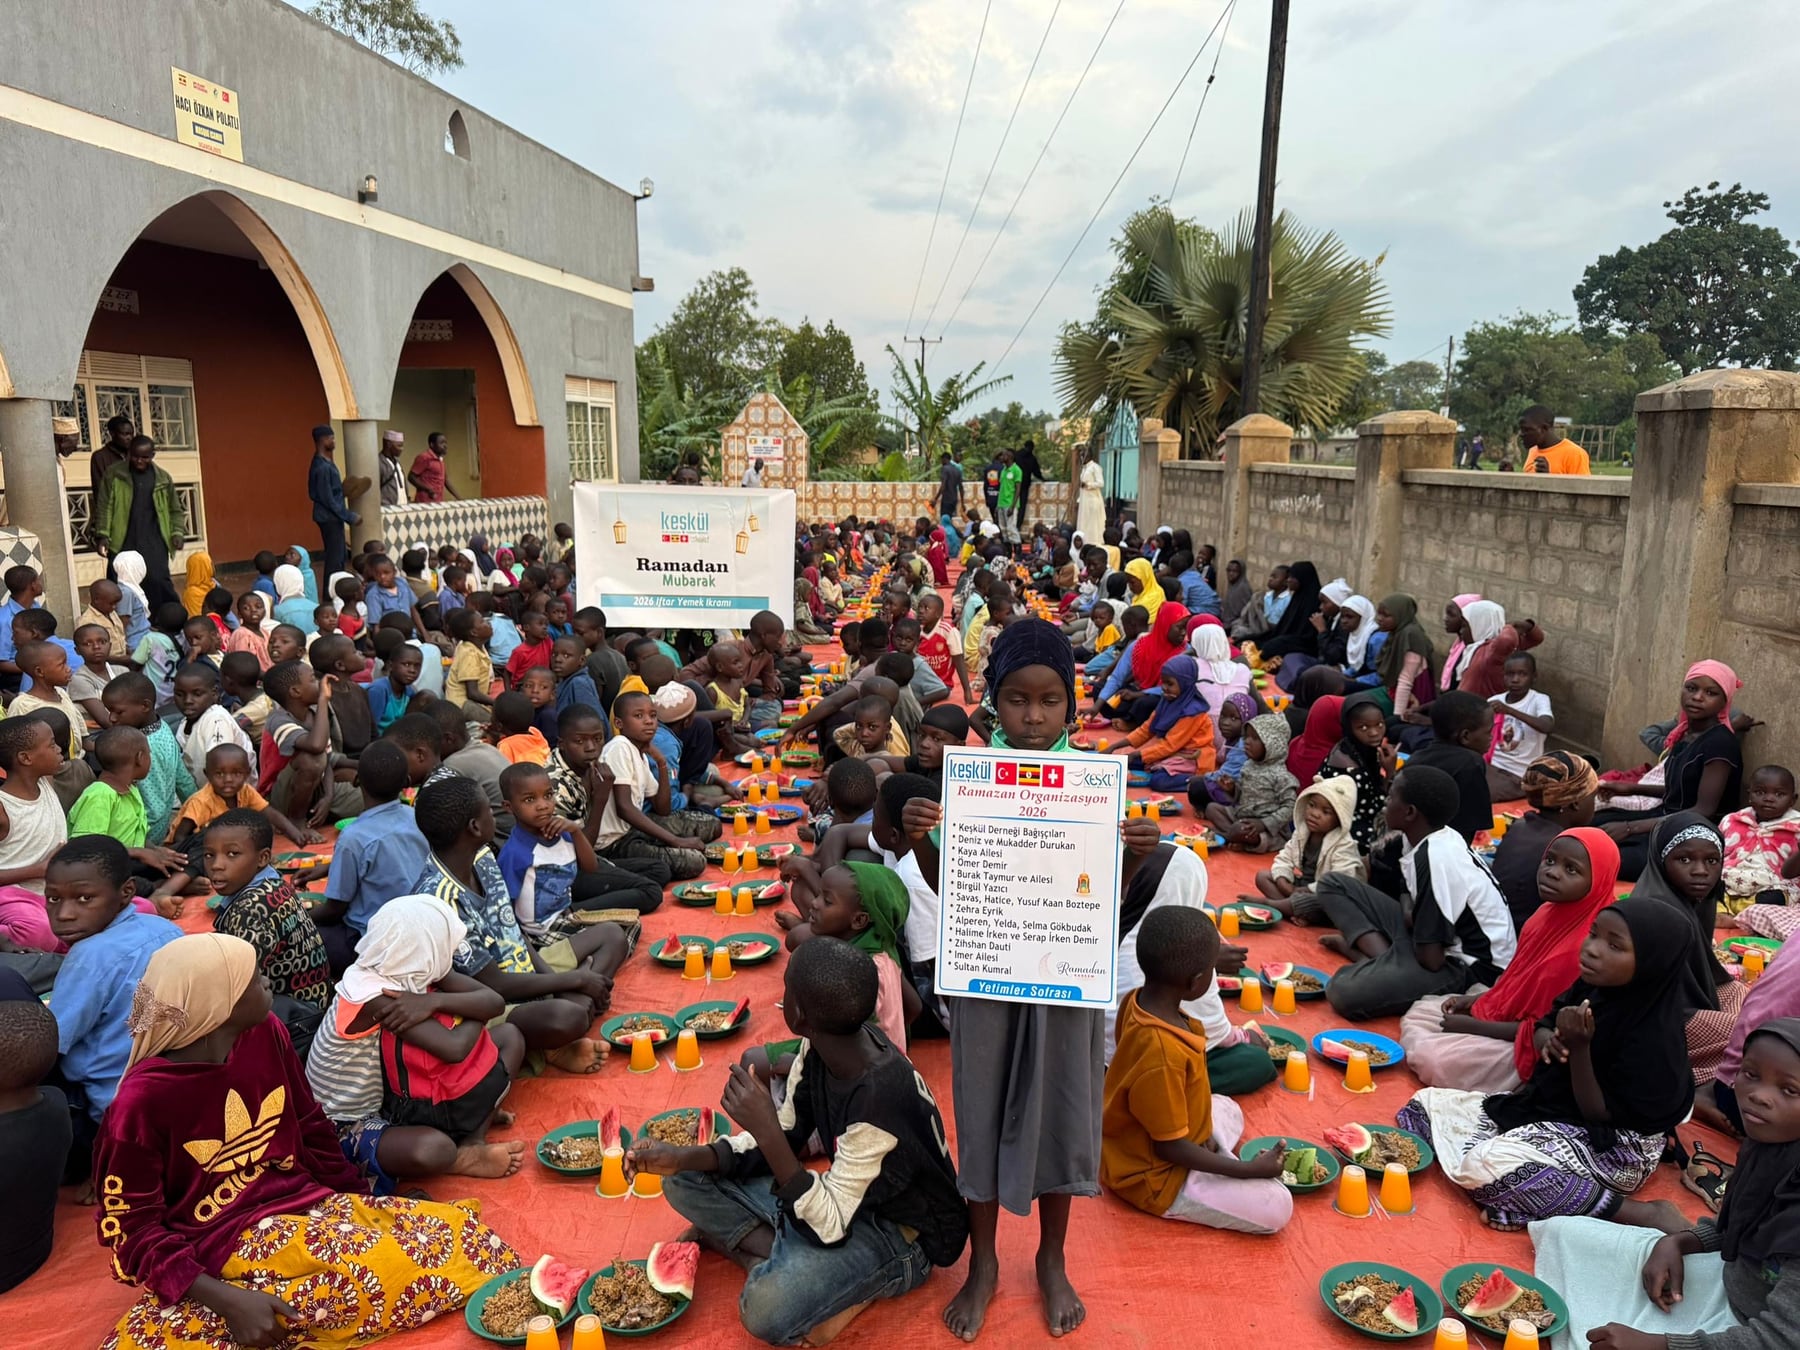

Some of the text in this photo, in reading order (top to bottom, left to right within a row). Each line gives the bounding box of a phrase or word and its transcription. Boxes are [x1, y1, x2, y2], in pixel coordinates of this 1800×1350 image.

[175, 95, 239, 130] HACI ÖZKAN POLATLI
[636, 557, 728, 572] Ramadan
[663, 574, 716, 587] Mubarak
[633, 596, 654, 606] 2026
[678, 598, 704, 606] Yemek
[957, 786, 1108, 806] Ramazan Organizasyon
[1019, 806, 1048, 818] 2026
[958, 823, 1066, 839] Keşkül Derneği Bağışçıları
[958, 835, 1076, 850] Deniz ve Mukadder Durukan
[958, 847, 1002, 858] Kaya Ailesi
[958, 858, 1008, 870] Ömer Demir
[957, 870, 1053, 884] Burak Taymur ve Ailesi
[957, 881, 1008, 893] Birgül Yazıcı
[956, 904, 1004, 916] Zehra Eyrik
[984, 895, 1013, 906] Hatice,
[1017, 897, 1040, 906] Yusuf
[1043, 899, 1063, 908] Kaan
[1066, 900, 1100, 911] Boztepe
[955, 916, 1092, 933] Alperen, Yelda, Selma Gökbudak
[955, 928, 984, 937] Halime
[1010, 933, 1020, 941] ve
[1023, 932, 1046, 944] Serap
[1049, 932, 1070, 943] İrken
[1074, 935, 1099, 944] Demir
[955, 939, 1011, 951] Zihshan Dauti
[976, 952, 998, 962] Ailesi
[954, 961, 1012, 975] Sultan Kumral
[1056, 960, 1107, 976] Ramadan
[979, 982, 1072, 999] Yetimler Sofrası
